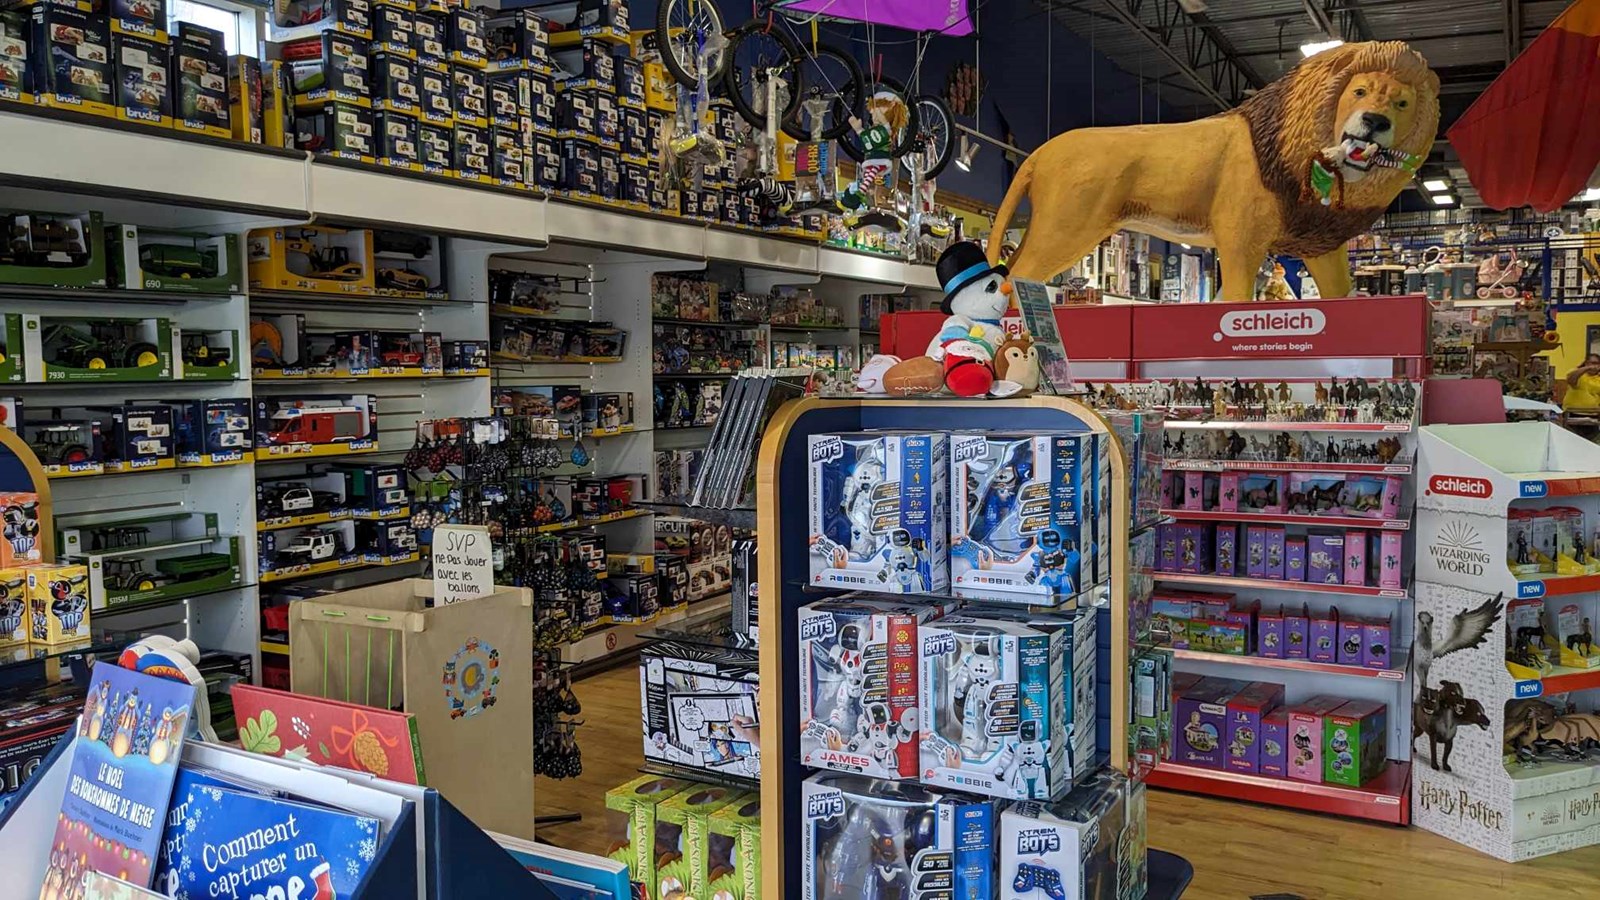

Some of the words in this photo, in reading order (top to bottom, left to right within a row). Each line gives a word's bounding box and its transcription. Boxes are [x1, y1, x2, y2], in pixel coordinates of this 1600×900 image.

[121, 20, 156, 36] bruder
[344, 22, 367, 34] bruder
[388, 42, 410, 53] bruder
[418, 57, 439, 69] bruder
[55, 93, 82, 105] bruder
[336, 90, 358, 101] bruder
[126, 106, 160, 122] bruder
[184, 119, 206, 129] bruder
[339, 151, 361, 162] bruder
[389, 157, 411, 168] bruder
[423, 164, 443, 175] bruder
[146, 280, 161, 289] 690
[1232, 312, 1313, 331] schleich
[1232, 343, 1257, 351] where
[1259, 342, 1287, 351] stories
[1289, 341, 1313, 352] begin
[48, 372, 65, 380] 7930
[283, 368, 303, 376] bruder
[351, 367, 370, 375] bruder
[350, 441, 373, 449] bruder
[212, 452, 243, 462] bruder
[813, 444, 840, 460] BOTS
[955, 443, 985, 460] BOTS
[69, 462, 100, 472] bruder
[131, 458, 157, 467] bruder
[1436, 480, 1485, 494] schleich
[1525, 483, 1542, 493] new
[655, 522, 689, 534] IRCUIT
[11, 537, 35, 552] TOP
[446, 531, 476, 553] SVP
[435, 553, 446, 564] ne
[1430, 546, 1491, 564] WIZARDING
[1437, 558, 1483, 576] WORLD
[437, 568, 460, 581] avec
[462, 570, 473, 581] les
[830, 575, 866, 584] ROBBIE
[973, 577, 1012, 586] ROBBIE
[448, 582, 480, 594] ballons
[1523, 583, 1540, 593] new
[61, 613, 83, 629] TOP
[801, 614, 831, 624] XTREM
[801, 619, 834, 638] BOTS
[924, 638, 955, 655] BOTS
[1520, 683, 1538, 693] new
[820, 752, 869, 767] JAMES
[98, 762, 108, 782] LE
[948, 775, 992, 788] ROBBIE
[808, 791, 840, 800] XTREM
[119, 798, 131, 820] DE
[808, 798, 843, 816] BOTS
[1419, 780, 1456, 815] Harry
[1458, 789, 1503, 832] Potter
[1568, 795, 1592, 820] Harry
[1018, 827, 1056, 837] XTREM
[203, 813, 300, 872] Comment
[1018, 834, 1059, 853] BOTS
[209, 851, 287, 900] capturer
[294, 842, 318, 862] un
